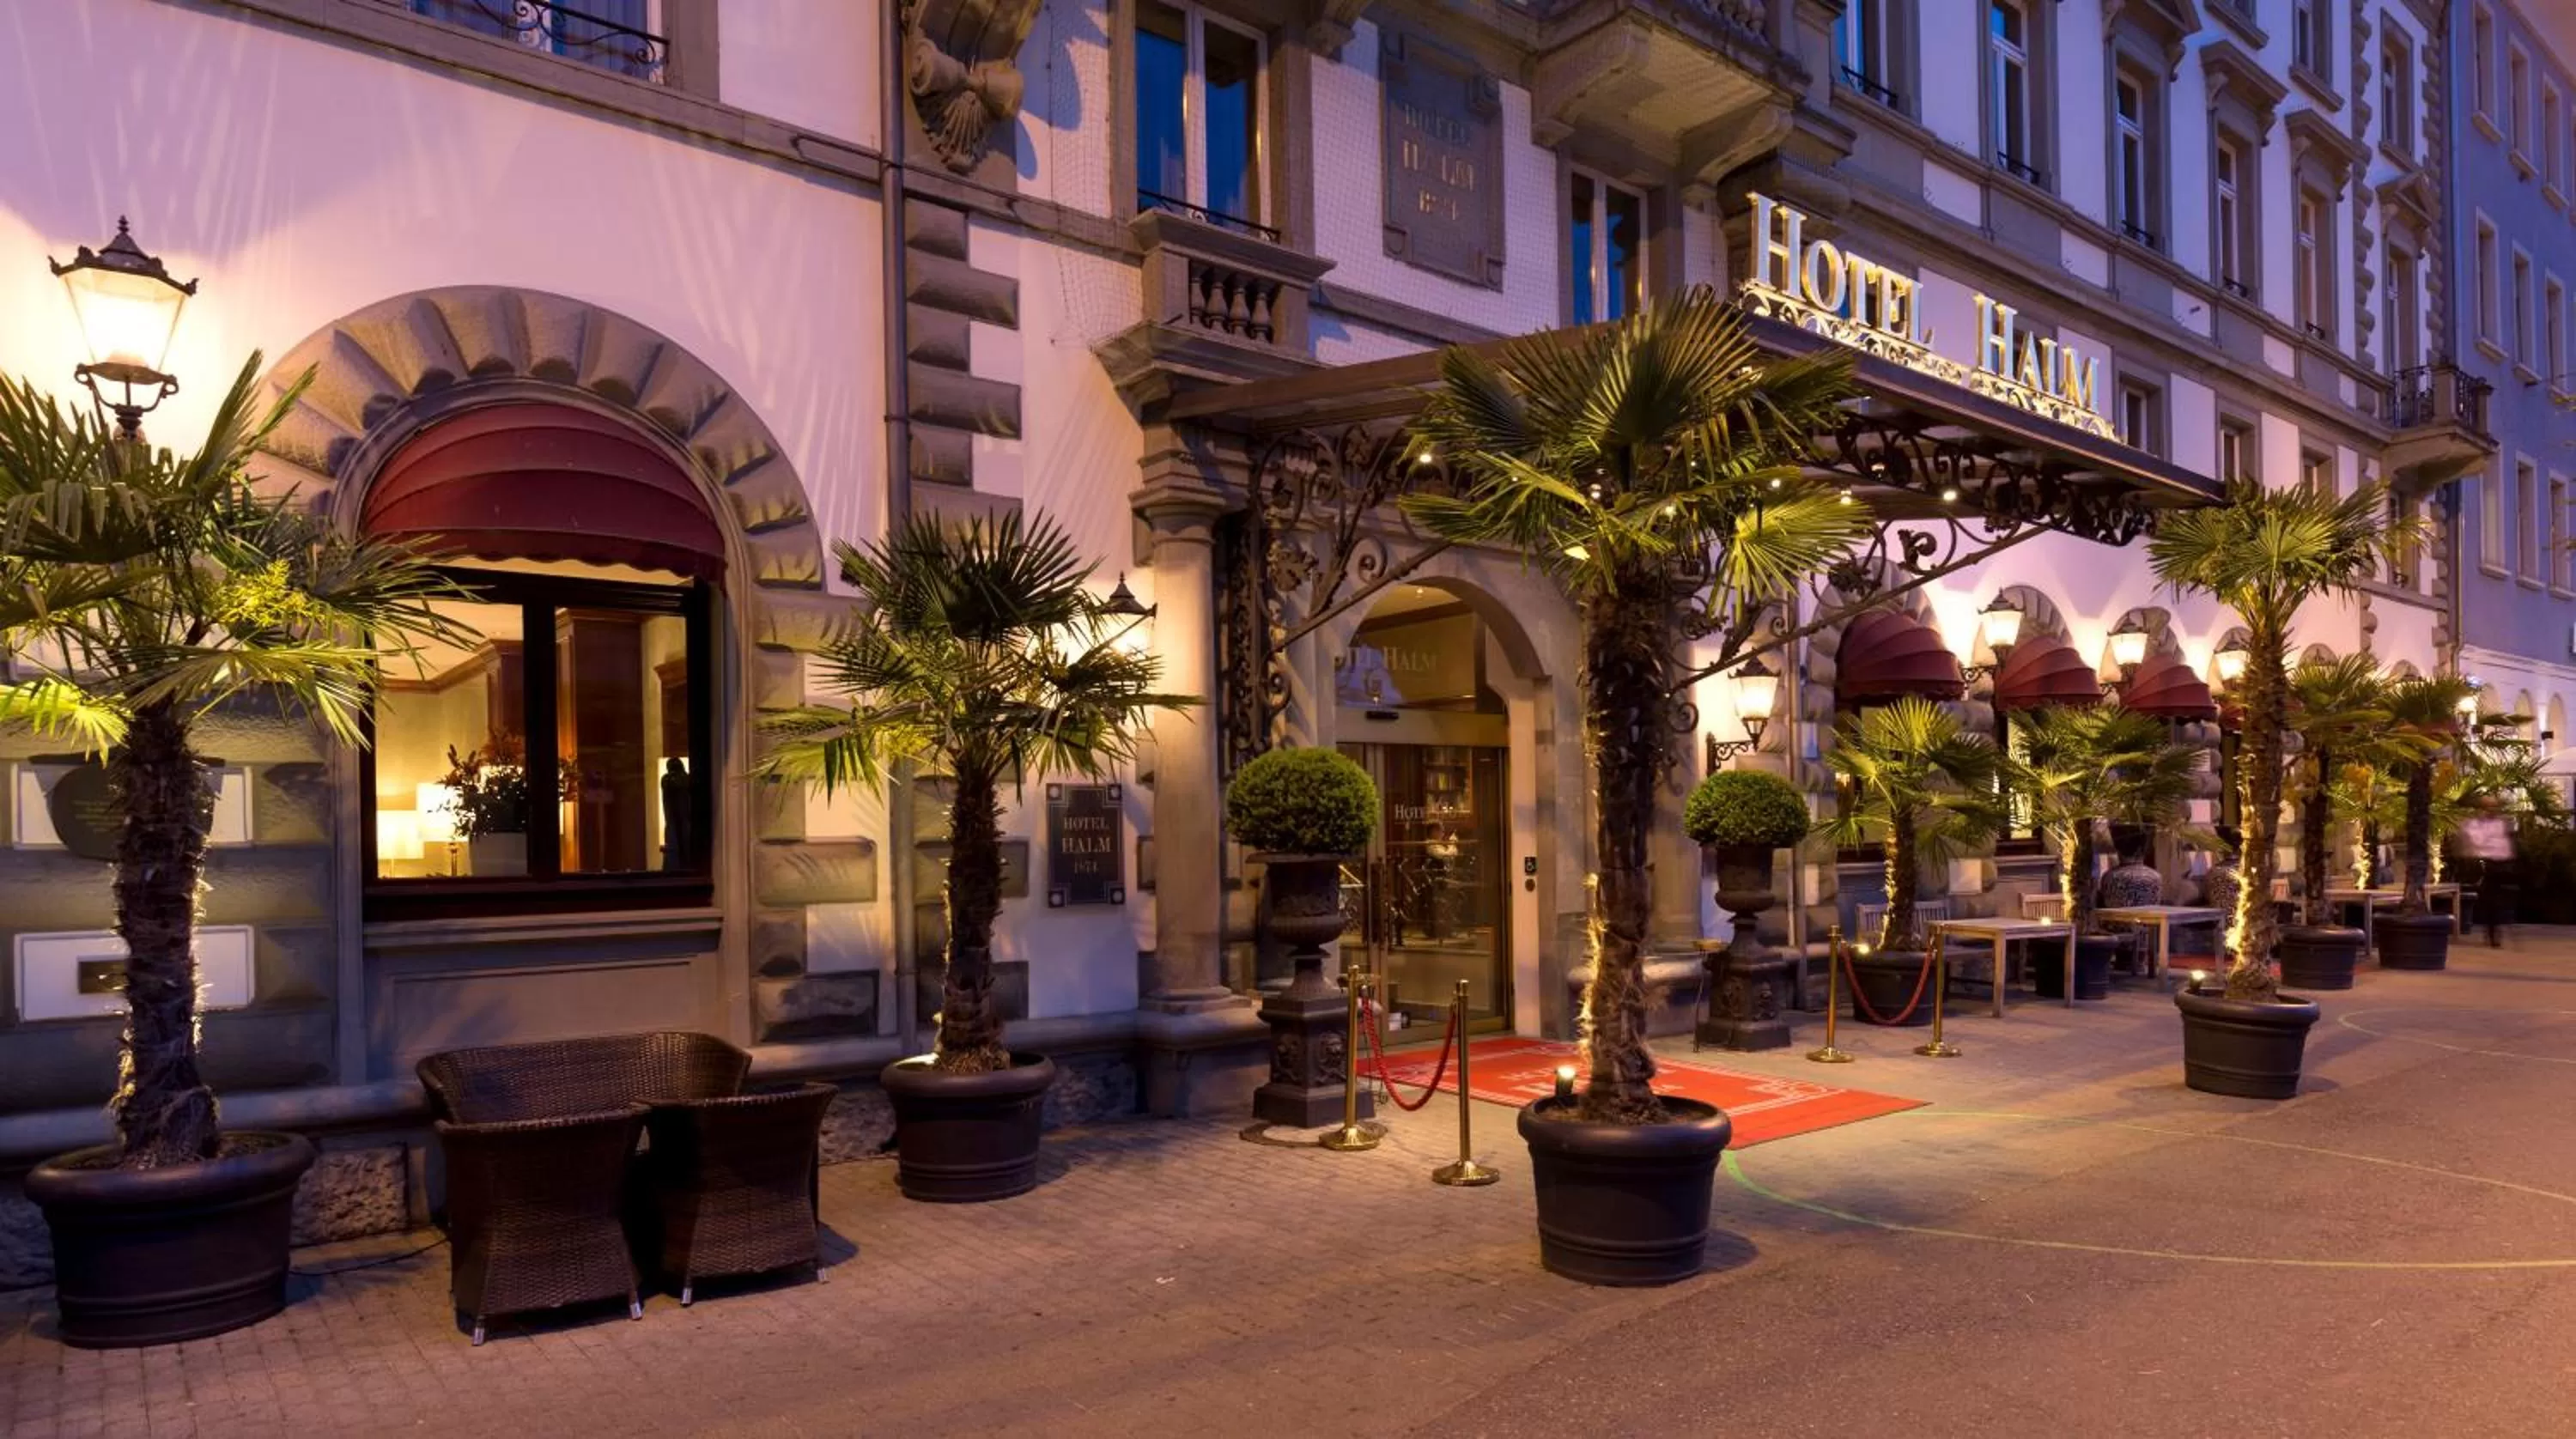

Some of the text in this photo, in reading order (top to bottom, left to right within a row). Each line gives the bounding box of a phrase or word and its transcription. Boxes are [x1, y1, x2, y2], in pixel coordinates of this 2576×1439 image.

[1747, 191, 2100, 414] HOTEL HALM
[1062, 817, 1110, 831] HOTEL
[1061, 837, 1113, 853] HALM
